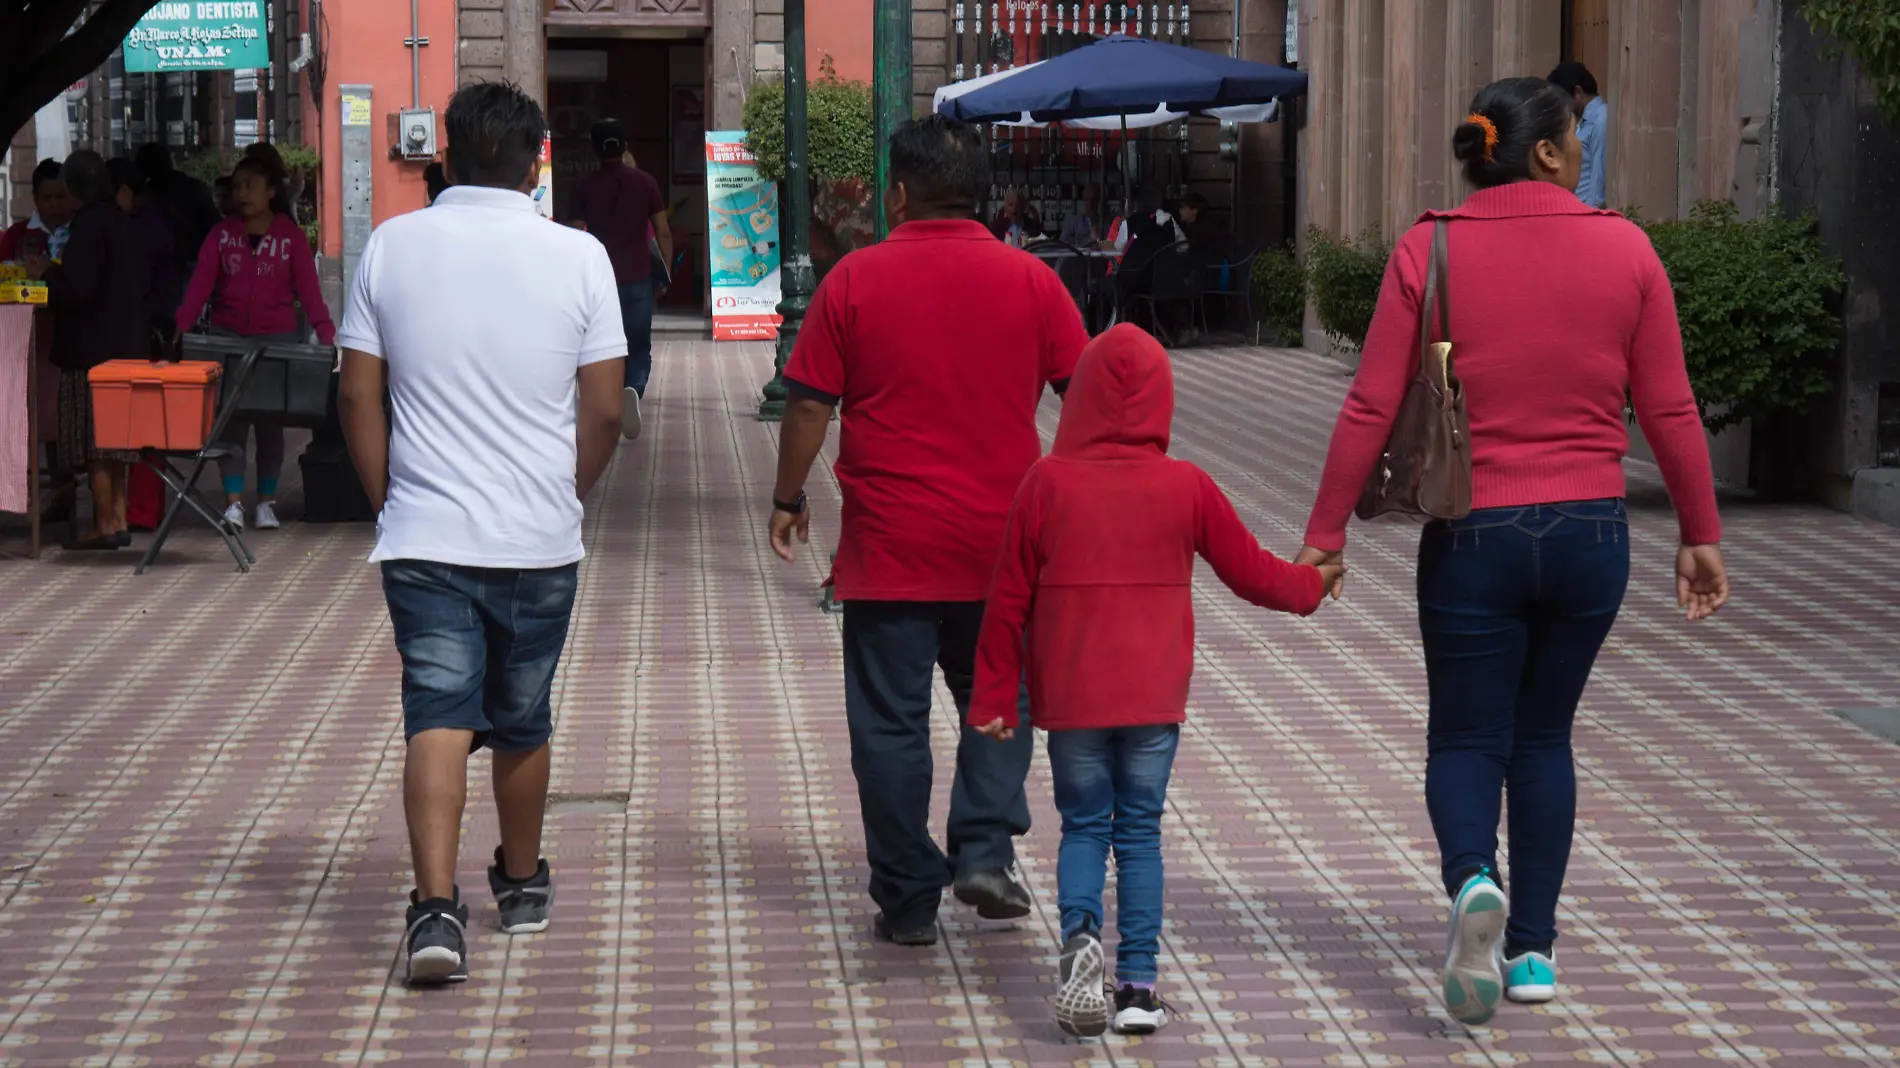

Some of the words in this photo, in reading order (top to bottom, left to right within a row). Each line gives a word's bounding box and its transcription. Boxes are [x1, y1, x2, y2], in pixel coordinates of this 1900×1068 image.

[197, 2, 259, 19] DENTISTA
[144, 28, 179, 49] Marco
[190, 26, 221, 46] Rojas
